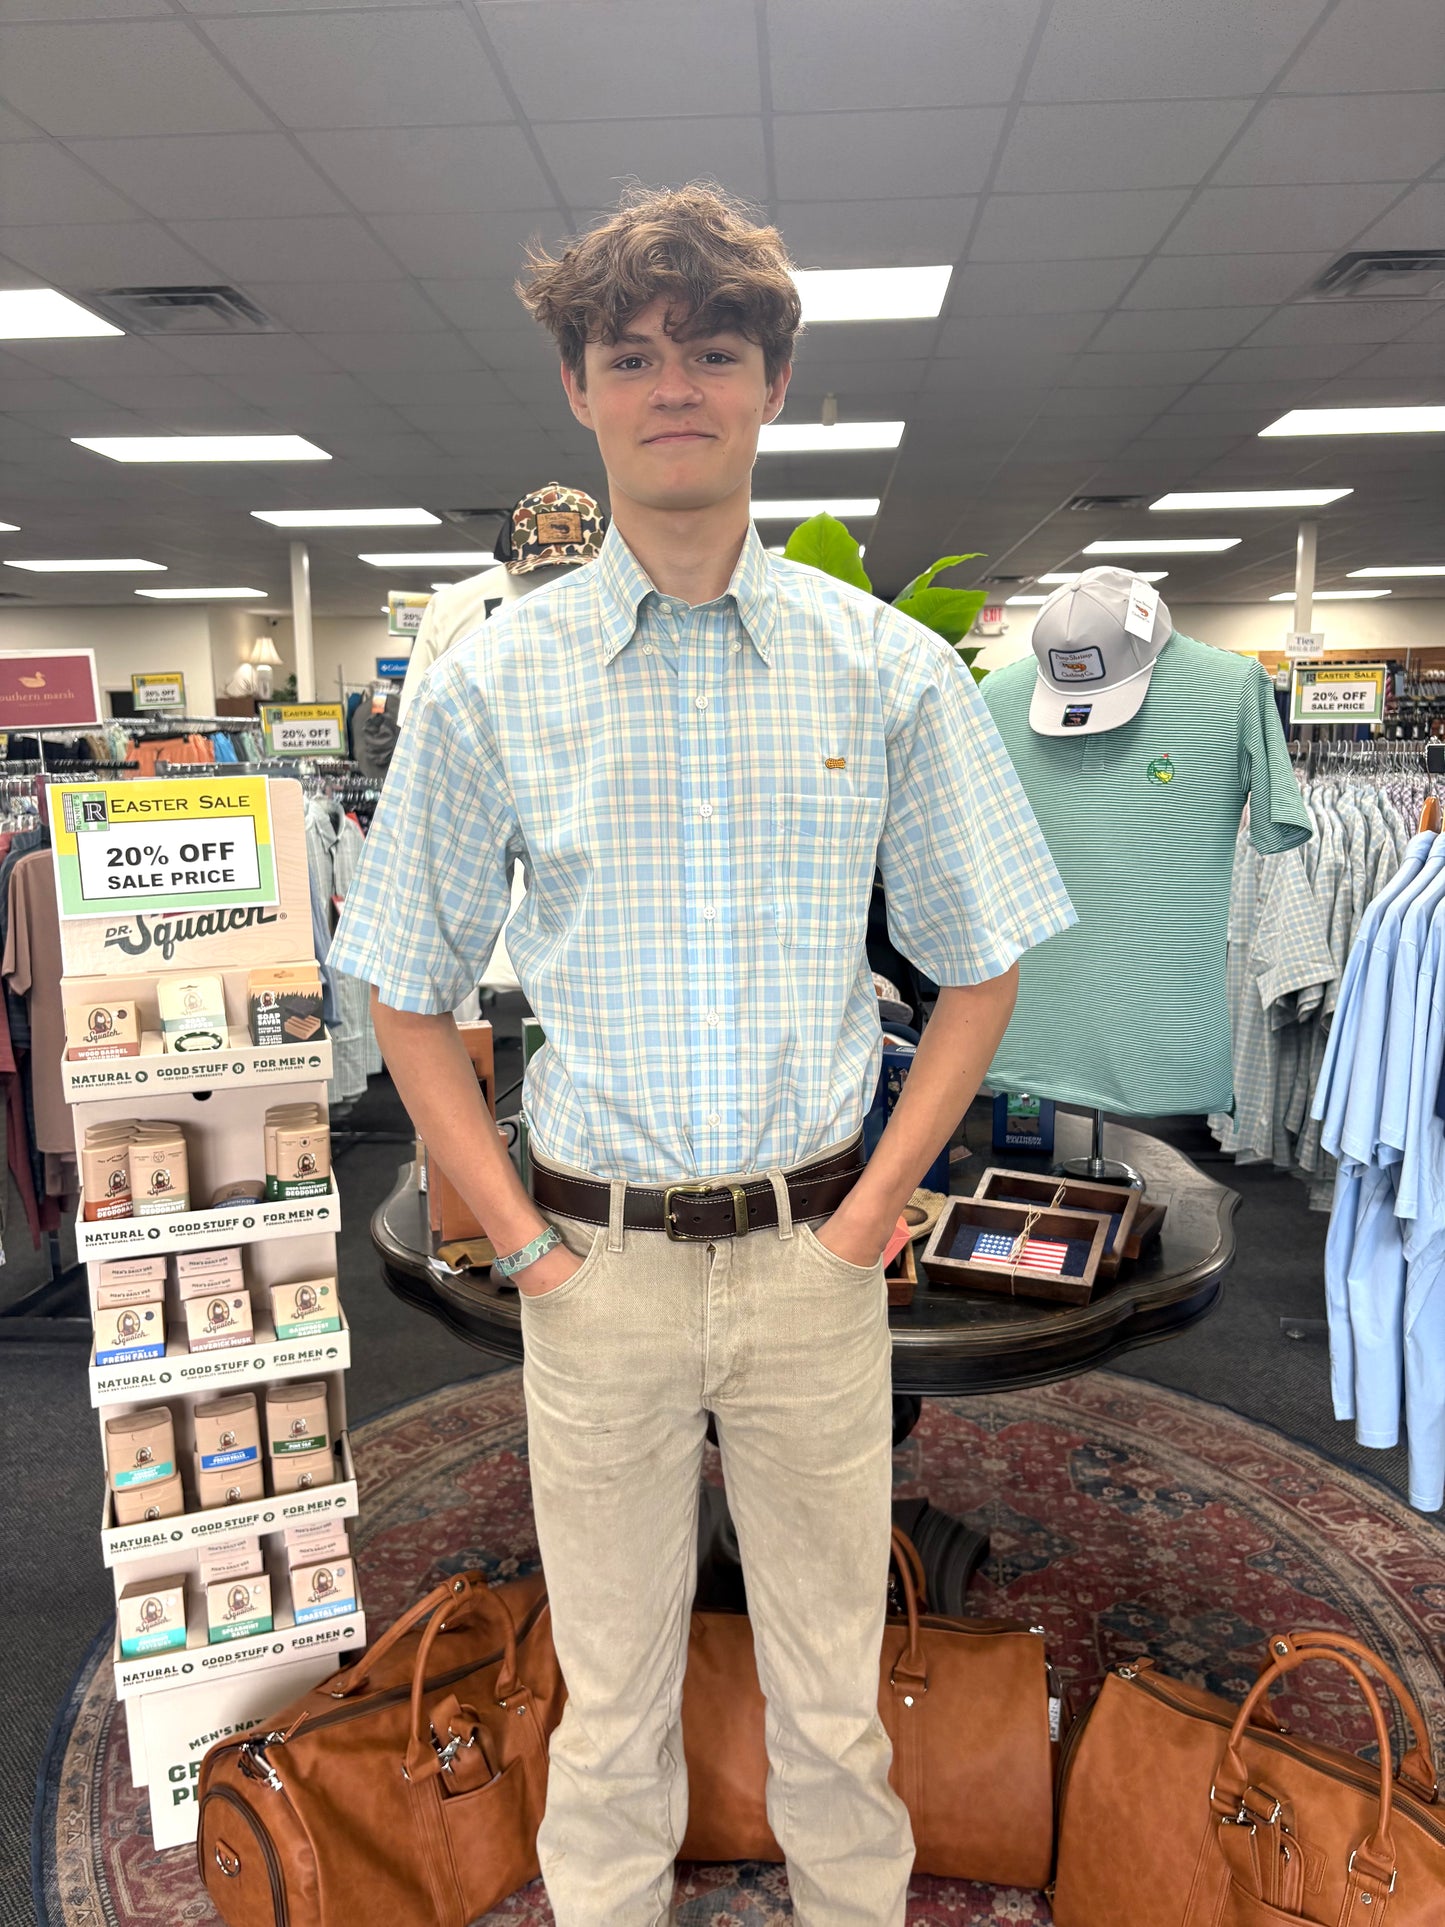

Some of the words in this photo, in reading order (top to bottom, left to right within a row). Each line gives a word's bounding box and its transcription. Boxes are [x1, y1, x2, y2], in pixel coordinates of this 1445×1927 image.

[983, 607, 1003, 623] EXIT
[1295, 636, 1314, 645] Ties
[1317, 672, 1350, 680] EASTER
[1354, 671, 1377, 679] SALE
[0, 689, 41, 702] outhern
[43, 688, 75, 700] marsh
[1312, 691, 1338, 701] 20%
[1342, 691, 1367, 701] OFF
[1337, 702, 1365, 710] PRICE
[283, 710, 314, 718] EASTER
[317, 709, 337, 717] SALE
[282, 729, 306, 739] 20%
[309, 728, 331, 738] OFF
[306, 739, 331, 747] PRICE
[110, 798, 188, 814] EASTER
[199, 794, 251, 809] SALE
[106, 845, 169, 867] 20%
[179, 841, 235, 863] OFF
[107, 873, 164, 890] SALE
[171, 869, 236, 886] PRICE
[105, 924, 133, 939] DR.
[257, 1012, 281, 1020] SOAP
[86, 1028, 121, 1044] Squatch
[78, 1050, 100, 1058] WOOD
[253, 1059, 276, 1069] FOR
[279, 1056, 305, 1067] MEN
[156, 1066, 189, 1077] GOOD
[191, 1063, 229, 1074] STUFF
[71, 1072, 132, 1085] NATURAL
[285, 1187, 328, 1197] DEODORANT
[97, 1205, 133, 1218] DEODORA
[140, 1203, 186, 1216] DEODORANT
[263, 1213, 286, 1222] FOR
[289, 1209, 314, 1219] MEN
[169, 1222, 201, 1233] GOOD
[203, 1218, 239, 1229] STUFF
[85, 1229, 144, 1243] NATURAL
[206, 1317, 236, 1333] Squatch
[192, 1341, 231, 1352] MAVERICK
[231, 1337, 252, 1346] MUSK
[103, 1353, 132, 1365] FRESH
[133, 1350, 159, 1360] FALLS
[273, 1353, 295, 1363] FOR
[298, 1348, 323, 1359] MEN
[181, 1365, 212, 1377] GOOD
[214, 1360, 249, 1372] STUFF
[97, 1374, 156, 1389] NATURAL
[283, 1505, 304, 1515] FOR
[307, 1499, 331, 1510] MEN
[191, 1522, 222, 1534] GOOD
[224, 1514, 260, 1527] STUFF
[110, 1533, 167, 1550] NATURAL
[298, 1608, 333, 1622] COASTAL
[222, 1622, 258, 1635] SPEARMINT
[292, 1636, 313, 1647] FOR
[316, 1629, 340, 1640] MEN
[202, 1654, 232, 1666] GOOD
[235, 1646, 269, 1659] STUFF
[123, 1666, 179, 1683] NATURAL
[188, 1726, 232, 1750] MEN'S
